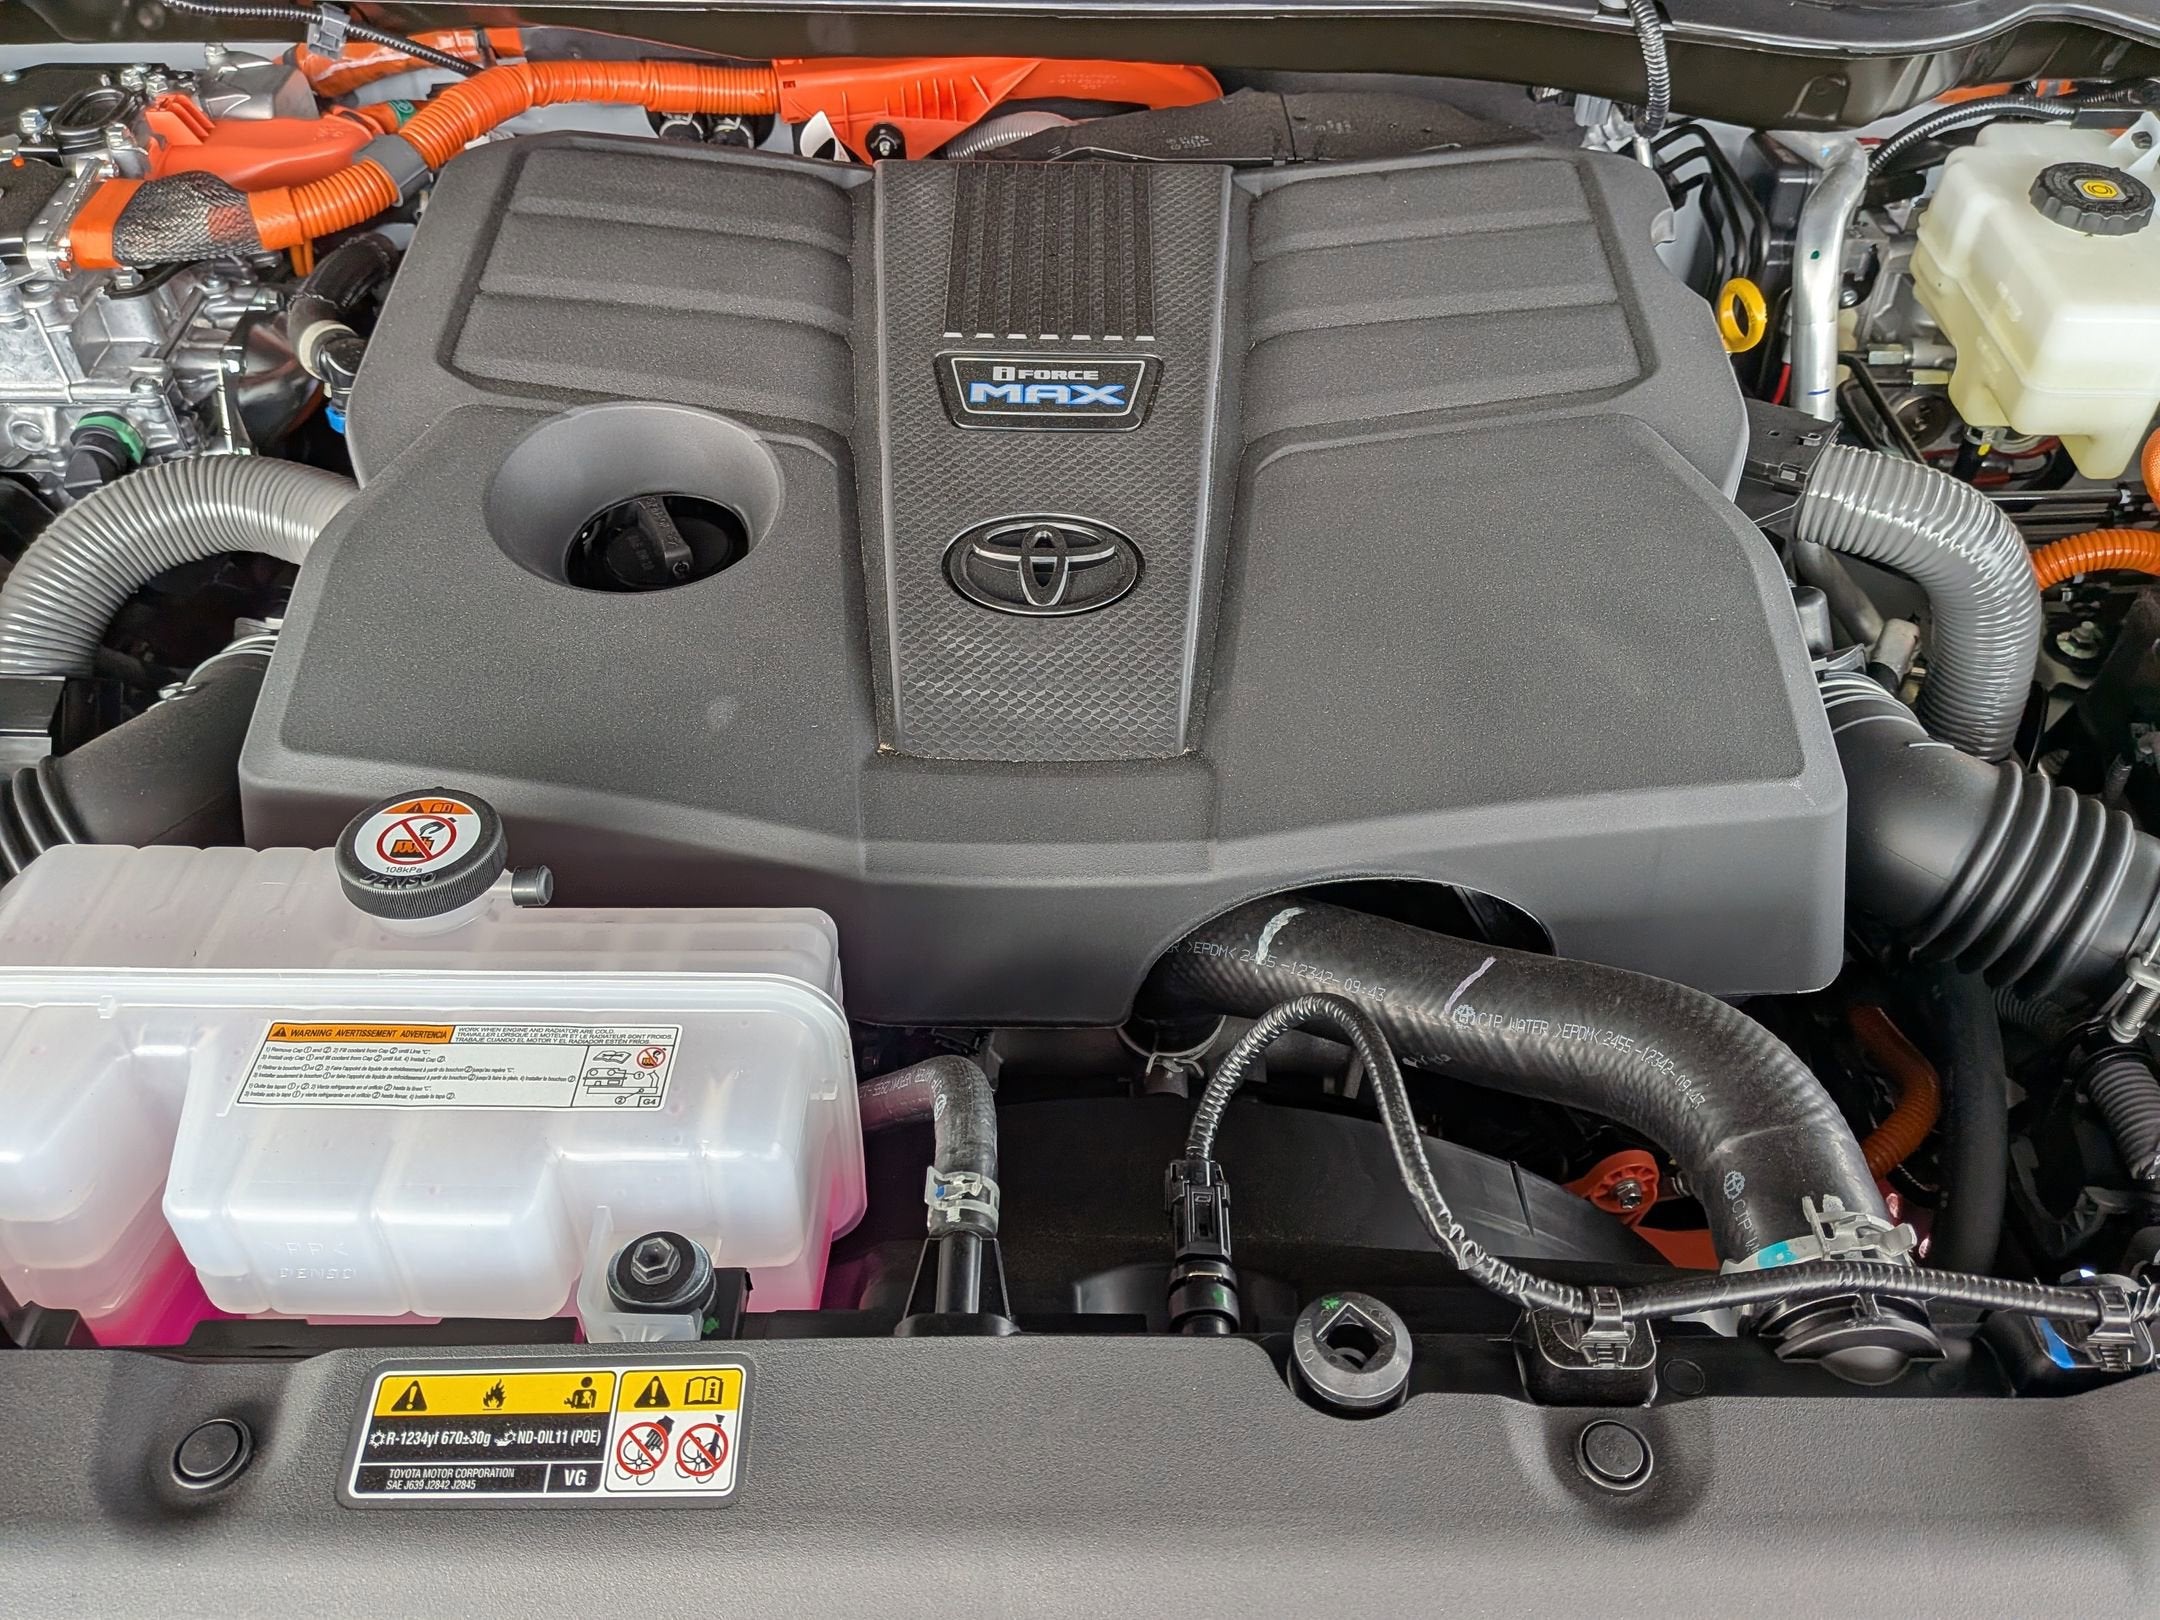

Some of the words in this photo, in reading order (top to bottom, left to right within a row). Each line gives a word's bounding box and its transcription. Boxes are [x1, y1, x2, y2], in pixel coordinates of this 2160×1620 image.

[1018, 370, 1099, 380] FORCE
[969, 382, 1126, 405] MAX
[385, 866, 423, 874] 108kPa
[359, 873, 437, 890] DENSO
[1509, 1018, 1550, 1035] WATER
[290, 1029, 333, 1037] WARNING
[335, 1029, 398, 1038] AVERTISSEMENT
[400, 1030, 447, 1039] ADVERTENCIA
[386, 1431, 440, 1448] R-1234yf
[440, 1430, 491, 1446] 670±30g
[517, 1430, 569, 1444] ND-OIL11
[570, 1429, 601, 1446] (POE)
[389, 1468, 422, 1479] TOYOTA
[423, 1468, 454, 1479] MOTOR
[454, 1468, 515, 1478] CORPORATION
[564, 1469, 587, 1486] VG
[386, 1480, 403, 1490] SAE
[404, 1480, 425, 1490] J639
[425, 1480, 451, 1490] J2842
[451, 1480, 476, 1489] J2845
